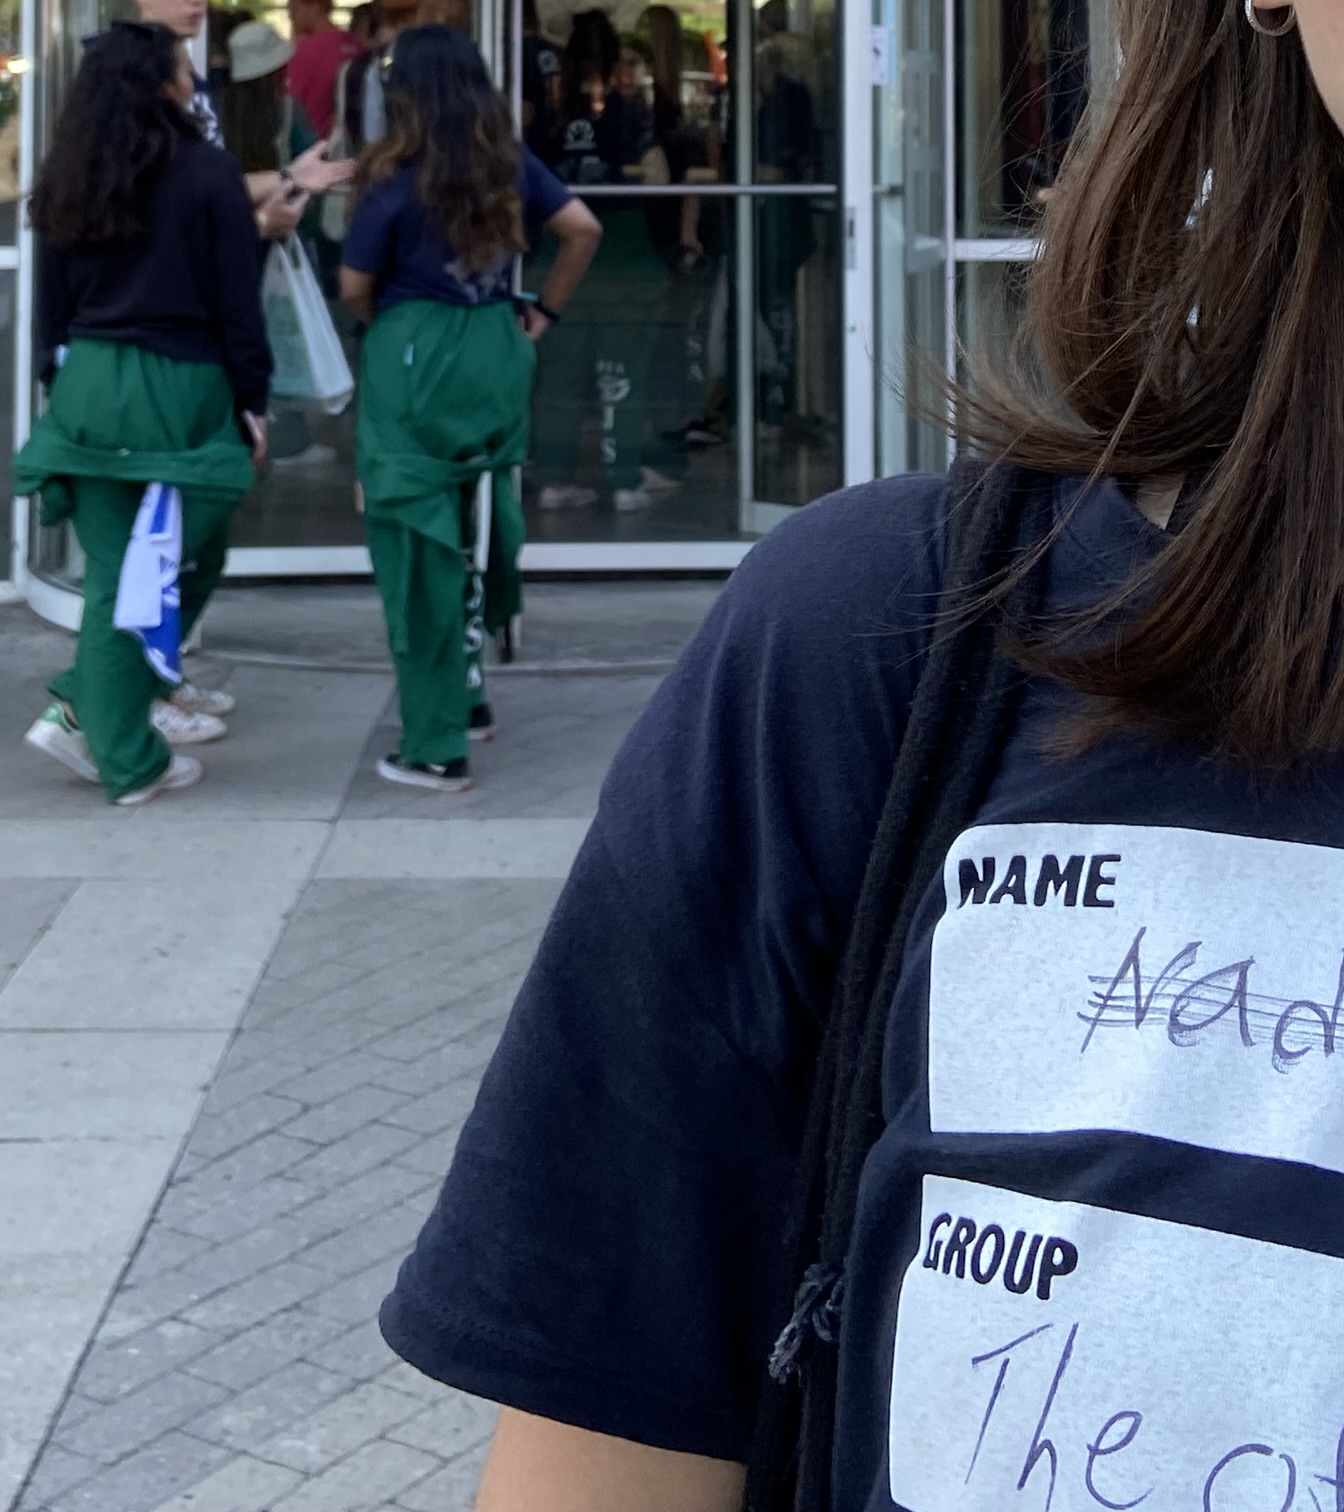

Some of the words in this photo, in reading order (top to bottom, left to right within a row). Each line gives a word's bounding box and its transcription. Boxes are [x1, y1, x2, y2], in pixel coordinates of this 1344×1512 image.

[957, 854, 1122, 909] NAME
[922, 1211, 1079, 1300] GROUP
[972, 1322, 1150, 1509] The
